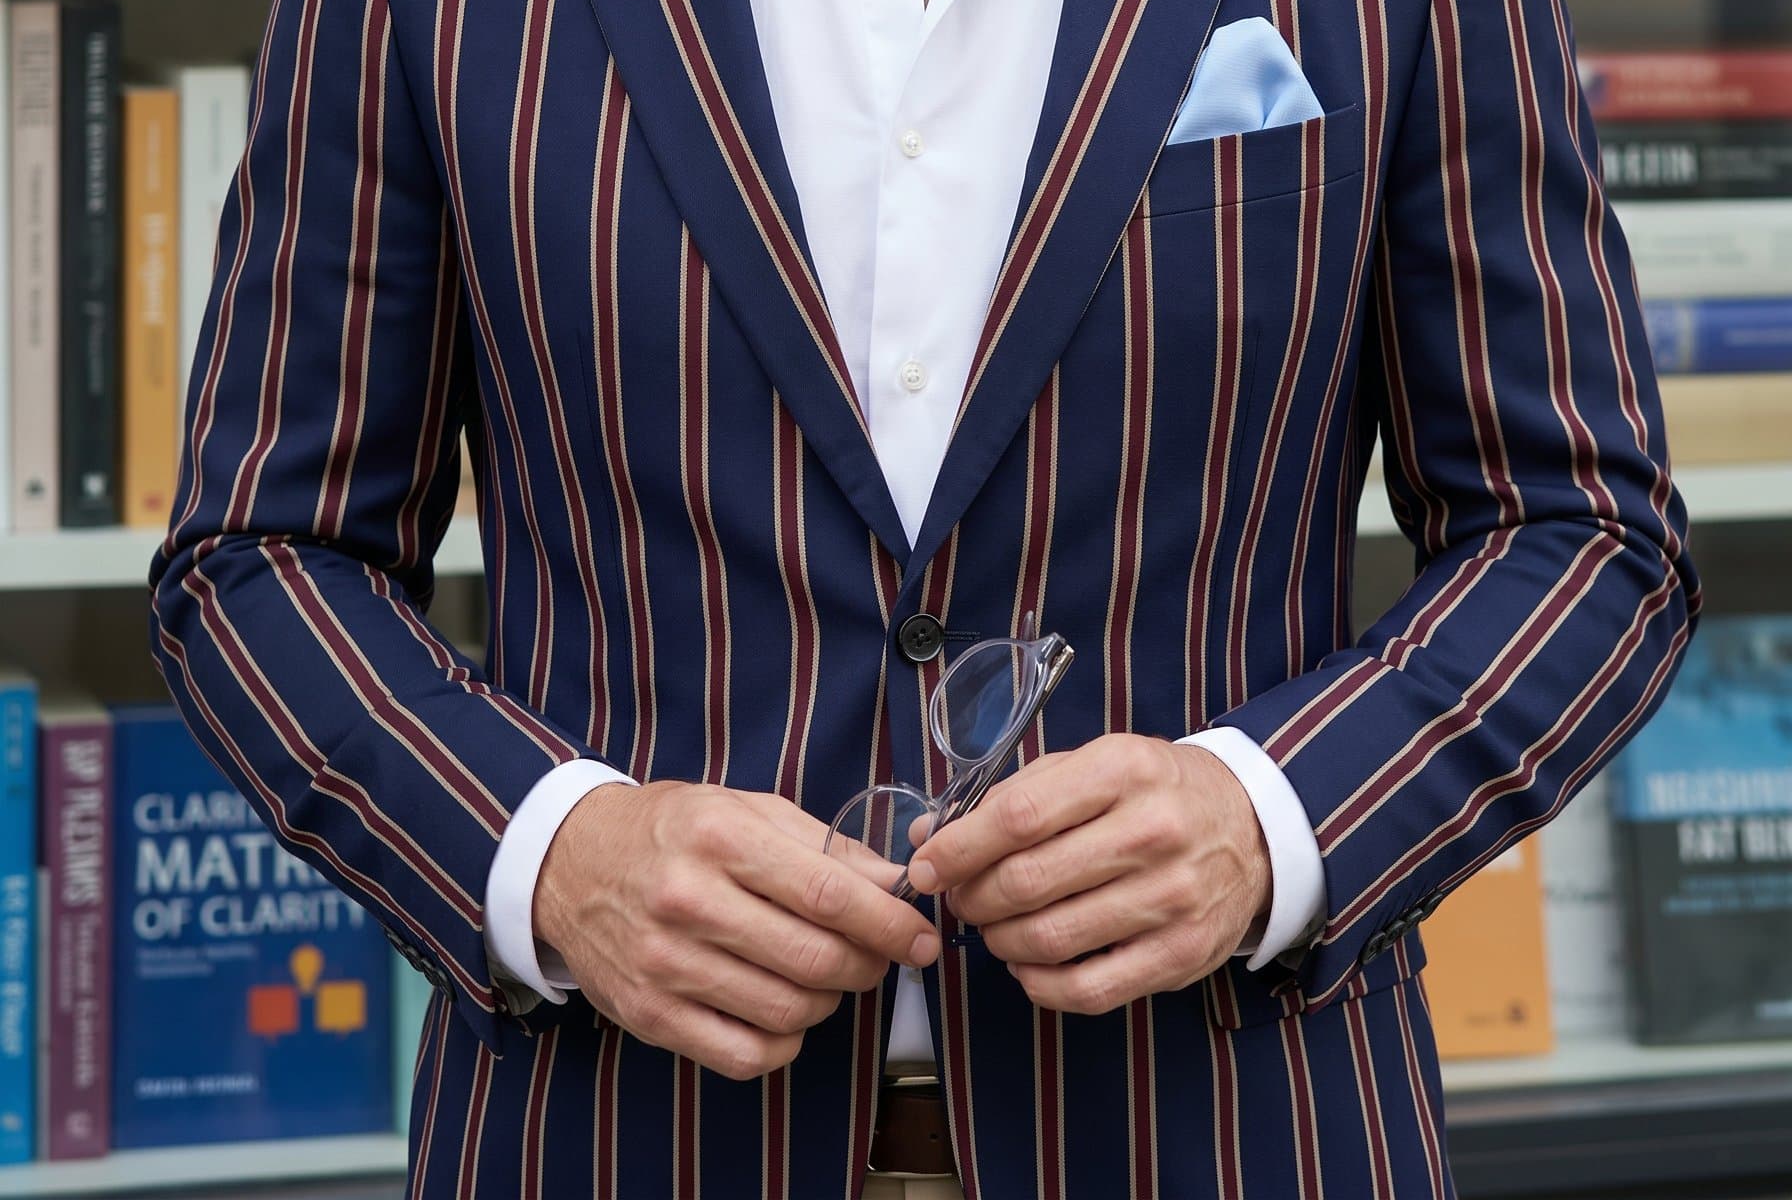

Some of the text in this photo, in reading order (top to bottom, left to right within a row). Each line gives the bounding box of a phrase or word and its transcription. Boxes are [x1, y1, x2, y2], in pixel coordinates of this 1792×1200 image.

[135, 832, 326, 893] MATR
[133, 890, 365, 940] OF CLARITY
